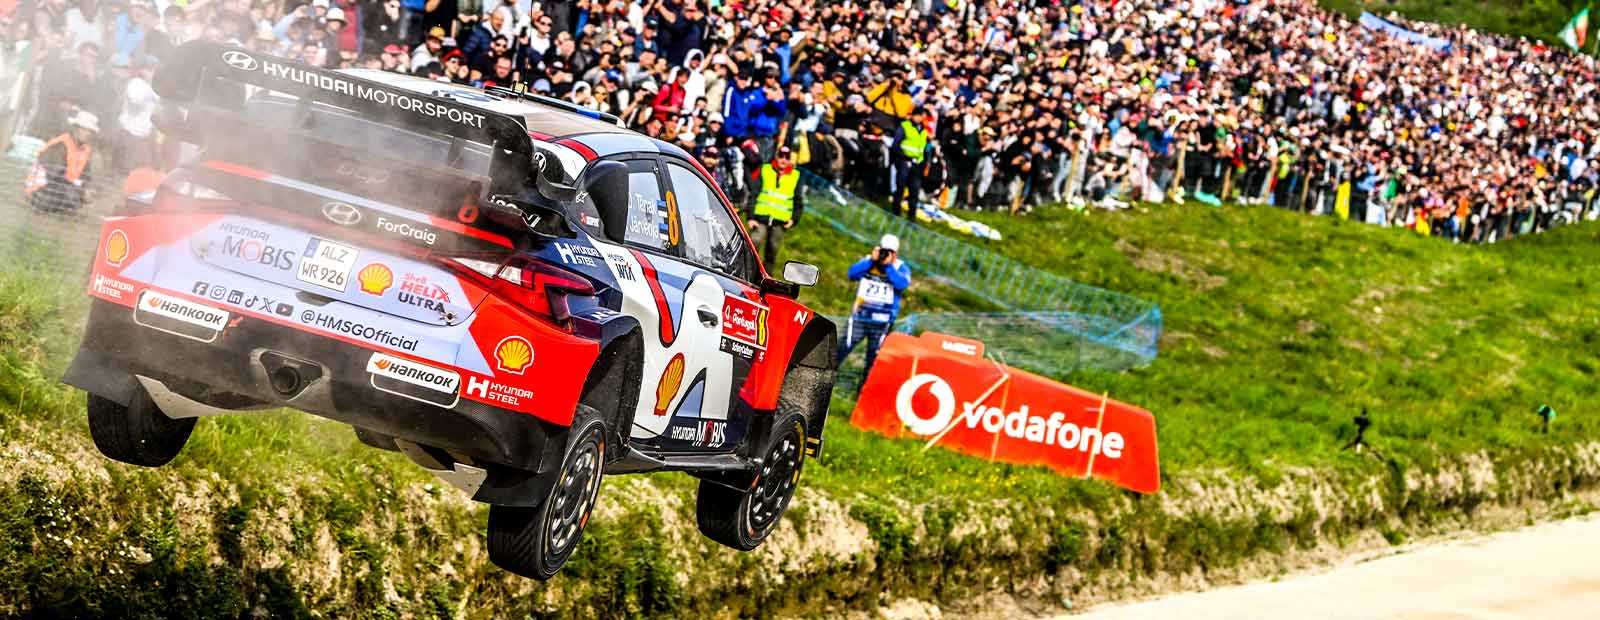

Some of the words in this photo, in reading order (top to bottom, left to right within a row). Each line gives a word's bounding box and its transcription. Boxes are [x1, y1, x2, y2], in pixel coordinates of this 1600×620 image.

[263, 60, 354, 96] HYUNDAI
[357, 84, 486, 129] MOTORSPORT
[219, 222, 271, 241] HYUNDAI
[376, 216, 437, 245] ForCraig
[665, 190, 679, 246] 8
[222, 235, 296, 271] MOBIS
[320, 245, 349, 263] ALZ
[301, 260, 319, 280] WR
[320, 267, 345, 286] 926
[397, 291, 447, 314] ULTRA
[400, 280, 450, 303] HELIX
[300, 308, 419, 352] @HMSGOfficial
[758, 309, 766, 346] 8
[488, 390, 520, 406] STEEL
[489, 381, 534, 400] HYUNDAI
[671, 425, 697, 441] HYUNDAI
[692, 418, 728, 448] MOBIS
[962, 401, 1125, 459] vodafone
